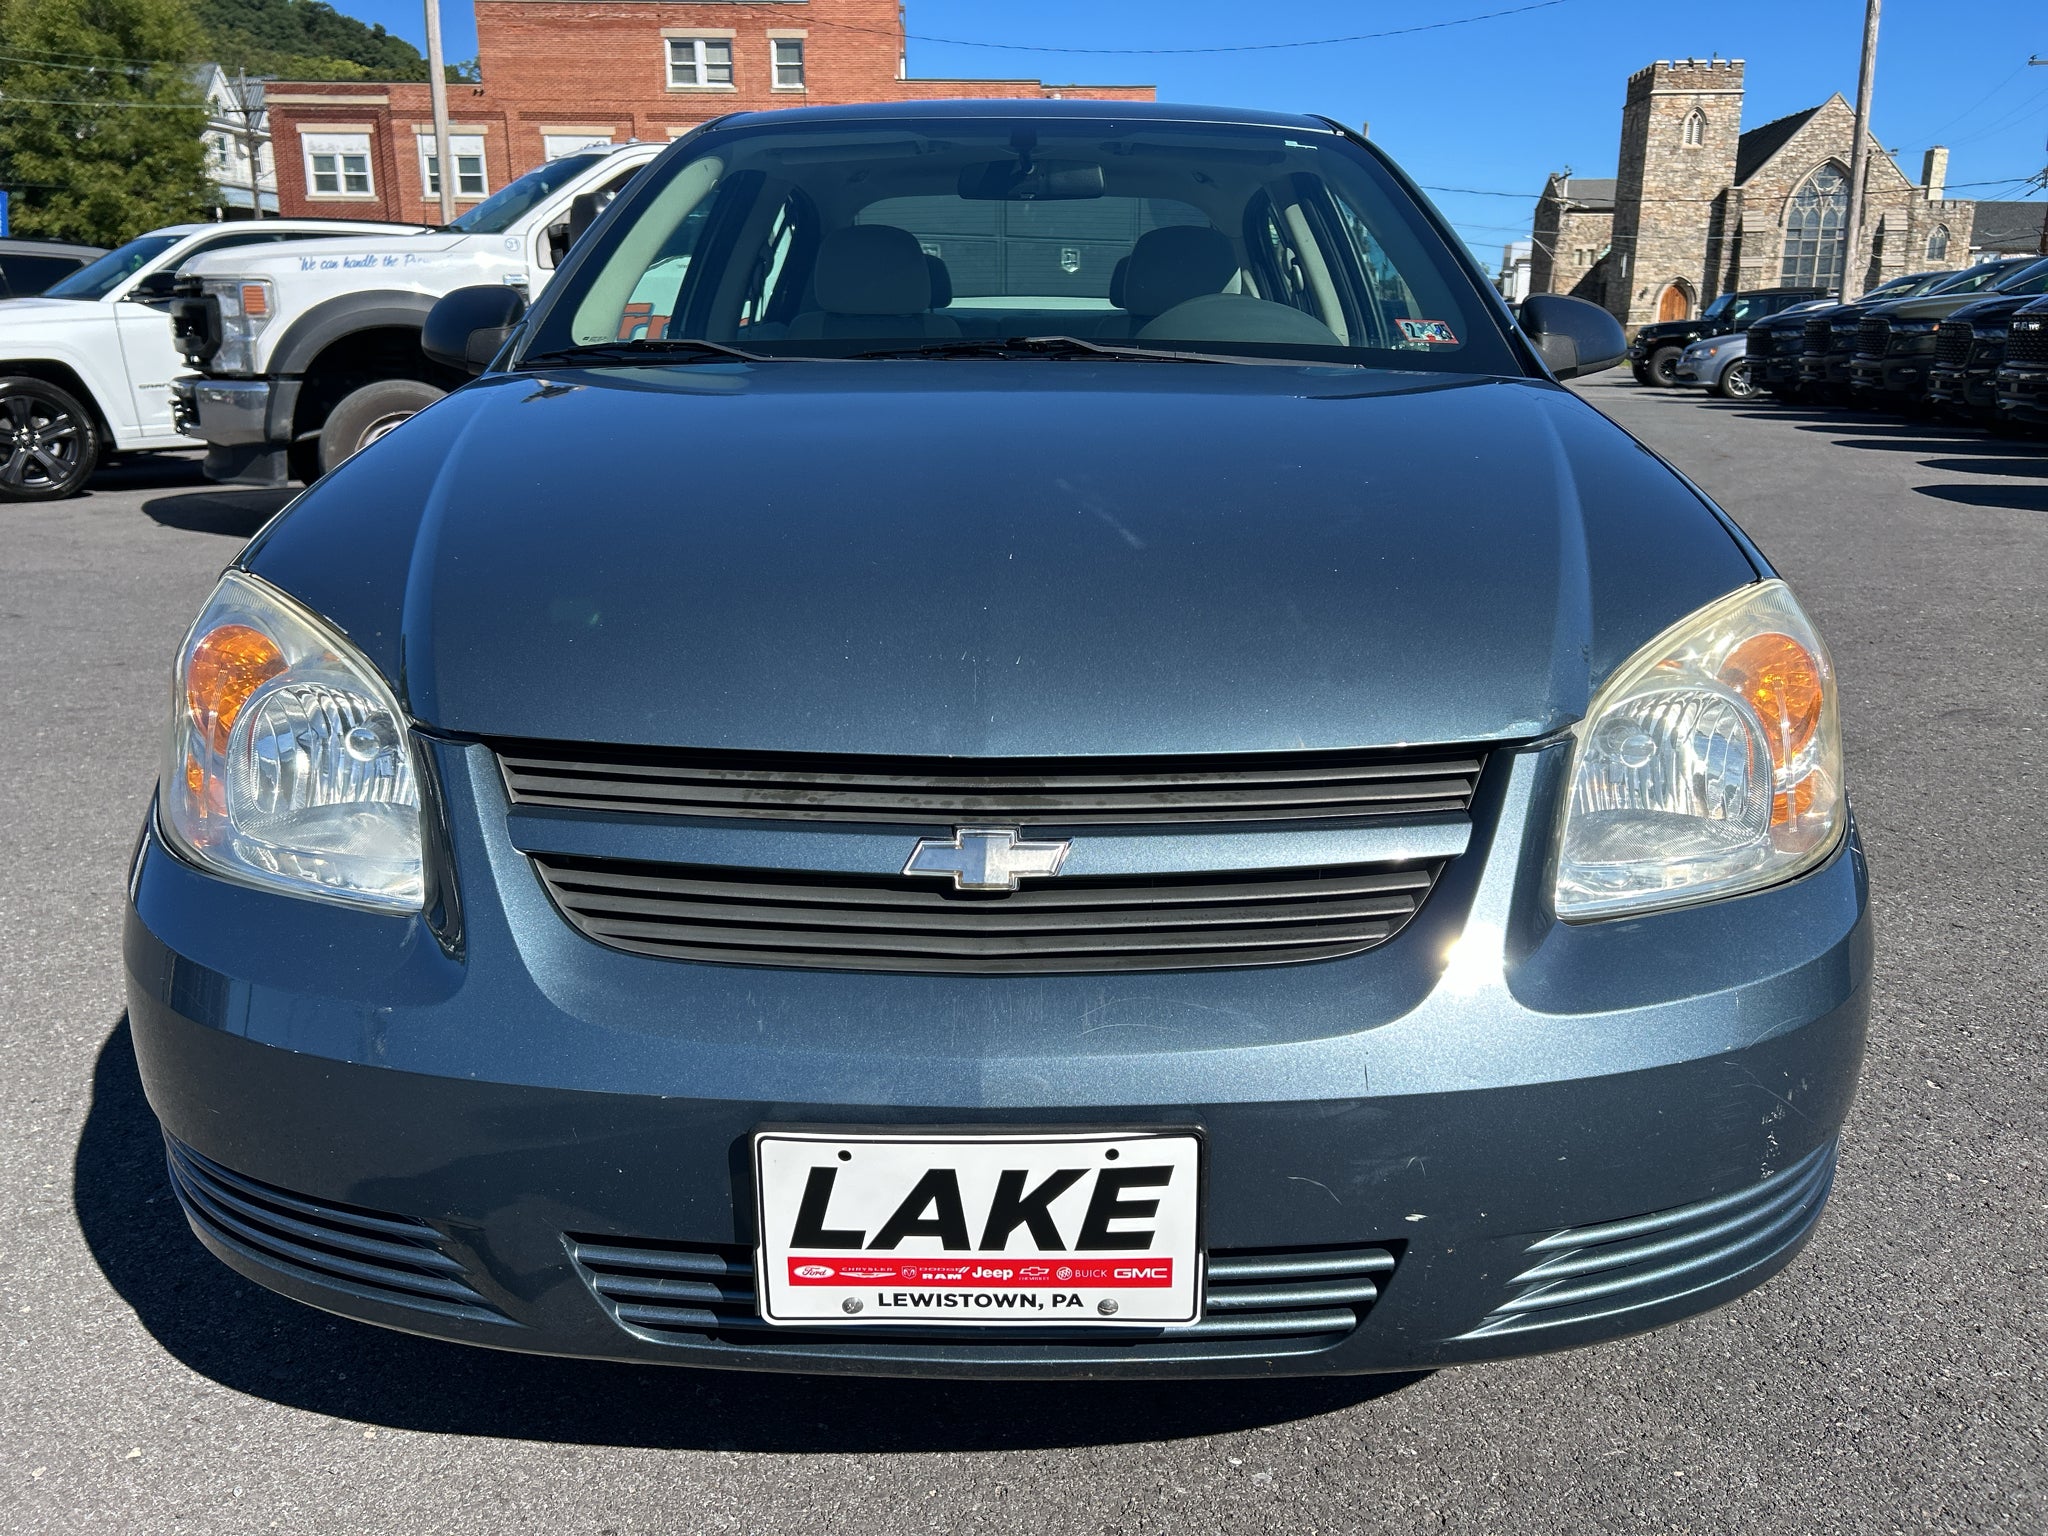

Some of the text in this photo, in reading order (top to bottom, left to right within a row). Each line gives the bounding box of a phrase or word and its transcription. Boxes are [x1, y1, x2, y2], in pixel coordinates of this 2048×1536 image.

[320, 259, 338, 270] can
[344, 254, 378, 269] handle
[383, 255, 398, 267] the
[789, 1164, 1175, 1251] LAKE
[802, 1267, 827, 1276] Ford
[972, 1266, 1014, 1281] Jeep
[1075, 1270, 1108, 1278] BUICK
[1114, 1268, 1168, 1279] GMC
[878, 1292, 1084, 1310] LEWISTOWN, PA
